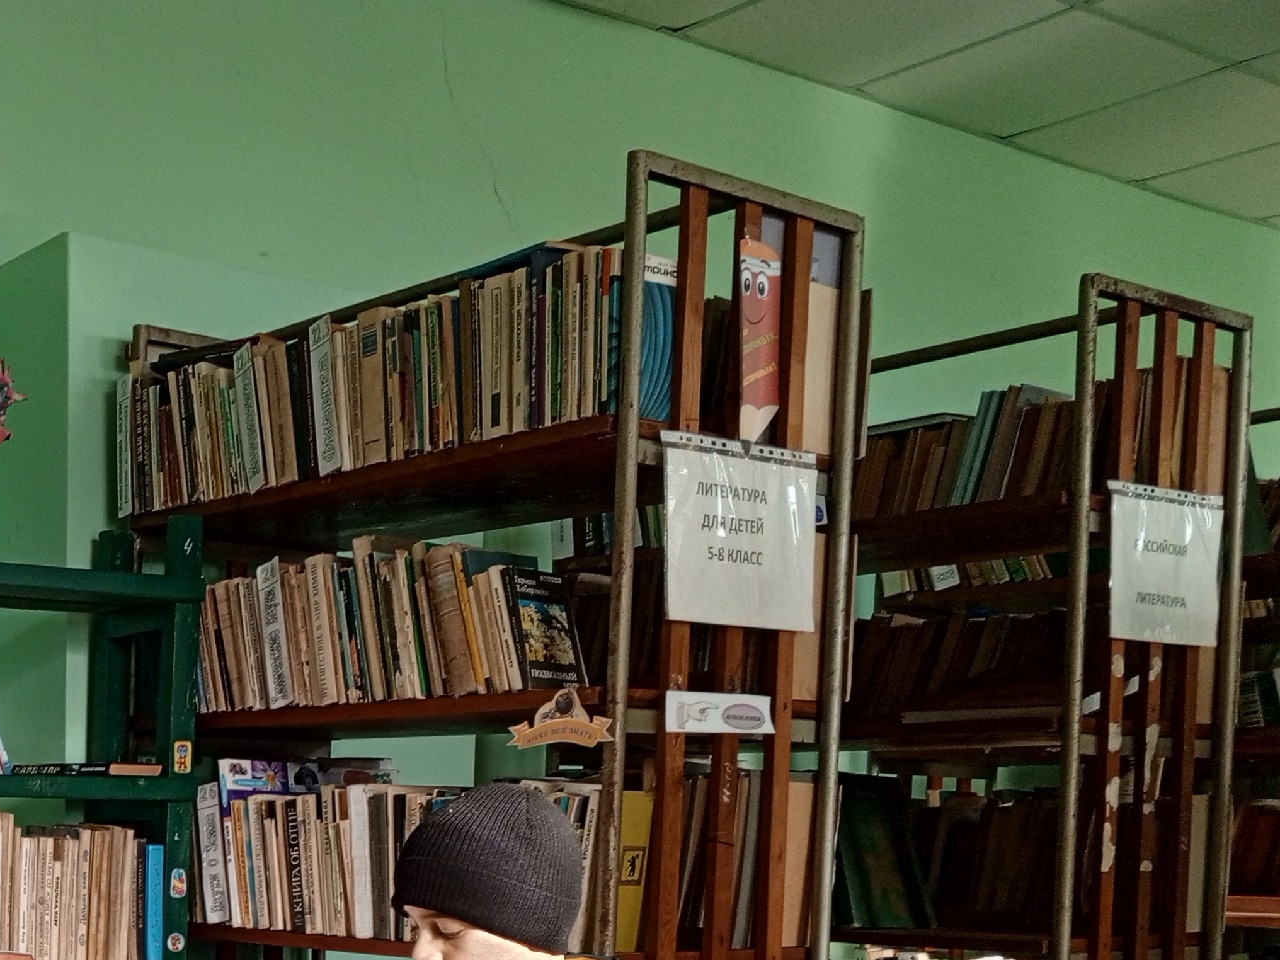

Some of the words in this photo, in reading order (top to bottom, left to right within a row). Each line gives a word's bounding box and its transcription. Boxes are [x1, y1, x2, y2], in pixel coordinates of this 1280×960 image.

[696, 481, 768, 504] ЛИТЕРАТУРА
[702, 514, 726, 531] ДЛЯ
[729, 517, 764, 535] ДЕТЕЙ
[183, 538, 193, 555] 4
[707, 546, 724, 561] 5-8
[727, 549, 763, 566] КЛАСС
[1136, 591, 1187, 608] ЛИТЕРАТУРА
[526, 729, 550, 743] ХОЧУ
[569, 728, 593, 740] ЗНАТЬ
[287, 806, 299, 844] ОТЦЕ
[289, 846, 300, 864] ОБ
[290, 866, 302, 912] КНИГА
